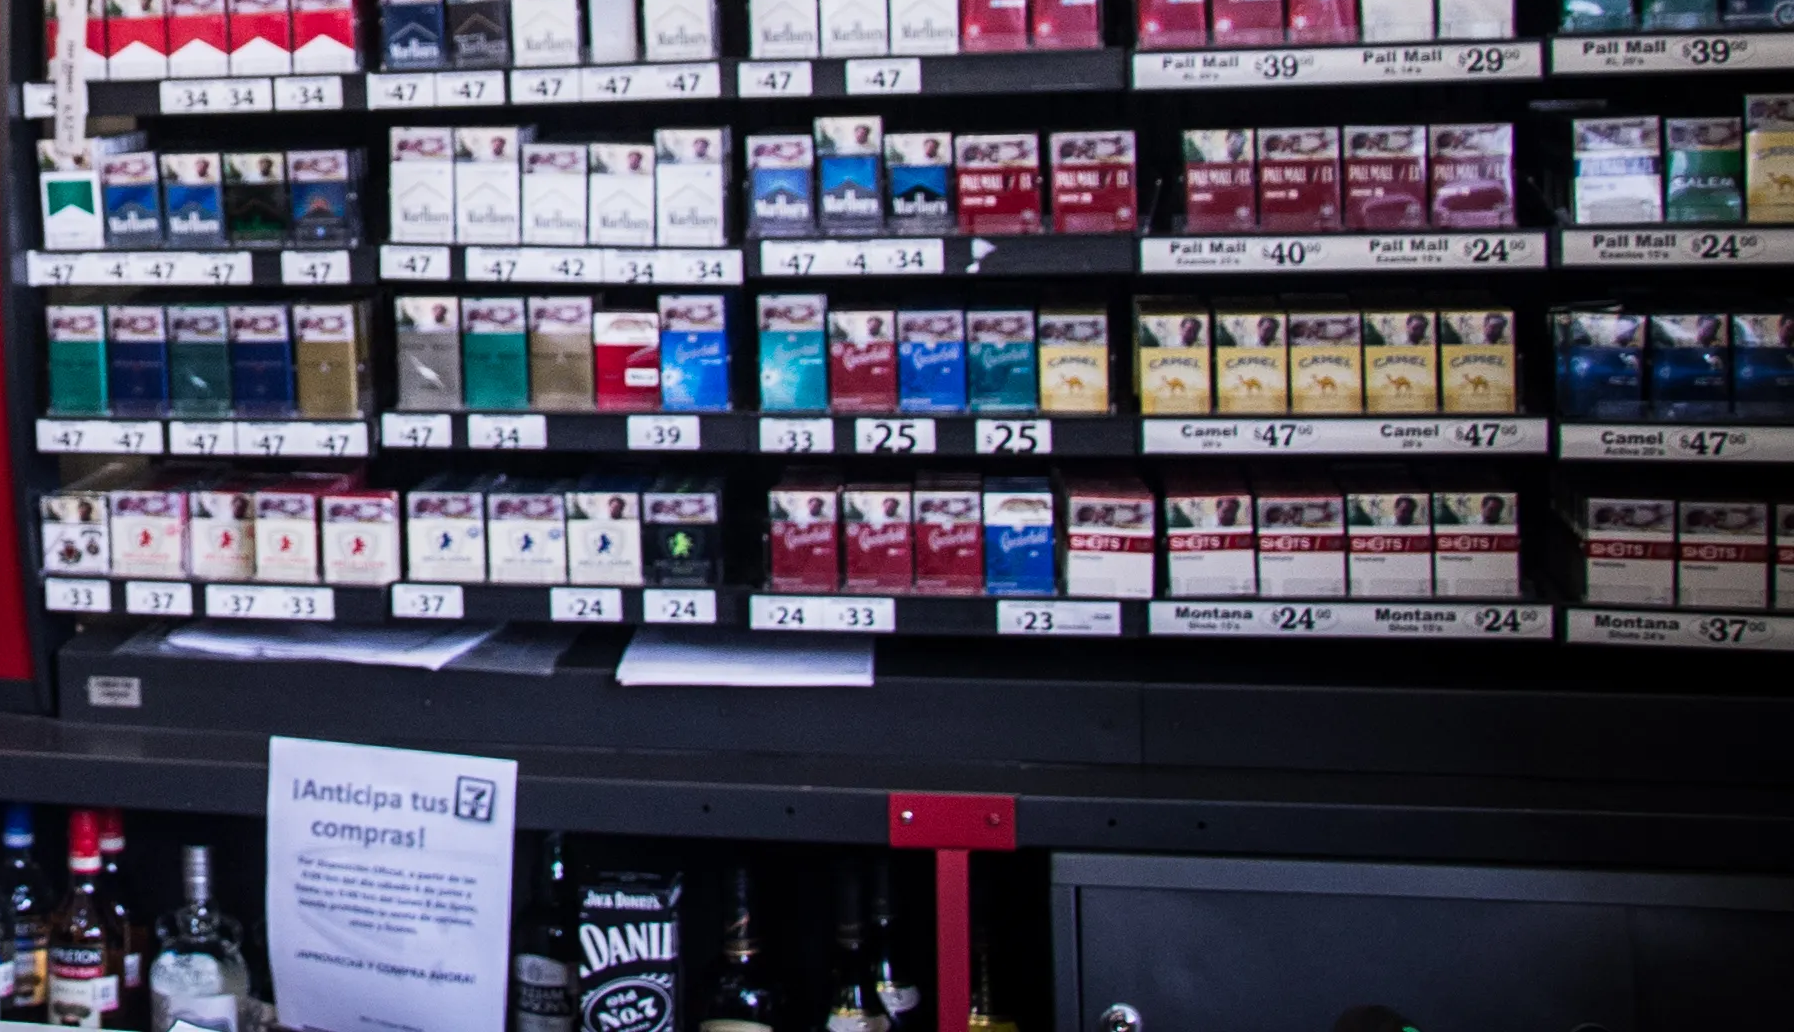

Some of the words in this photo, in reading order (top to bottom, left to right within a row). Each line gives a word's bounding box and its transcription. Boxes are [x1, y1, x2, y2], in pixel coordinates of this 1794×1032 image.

[1626, 39, 1667, 54] Mall
[1204, 55, 1239, 68] Mall
[1363, 50, 1397, 65] Pall
[1405, 48, 1443, 64] Mall
[1170, 240, 1202, 254] Pall
[1209, 238, 1246, 254] Mall
[1369, 239, 1403, 253] Pall
[1410, 238, 1449, 253] Mall
[1594, 234, 1628, 248] Pall
[1635, 233, 1676, 248] Mall
[1181, 424, 1238, 438] Camel
[1380, 424, 1439, 439] Camel
[1601, 431, 1663, 445] Camel
[1174, 606, 1254, 621] Montana
[1375, 608, 1456, 623] Montana
[1594, 614, 1680, 630] Montana
[292, 778, 403, 813] ¡Anticipa
[411, 791, 449, 815] tus
[311, 819, 426, 849] compras!
